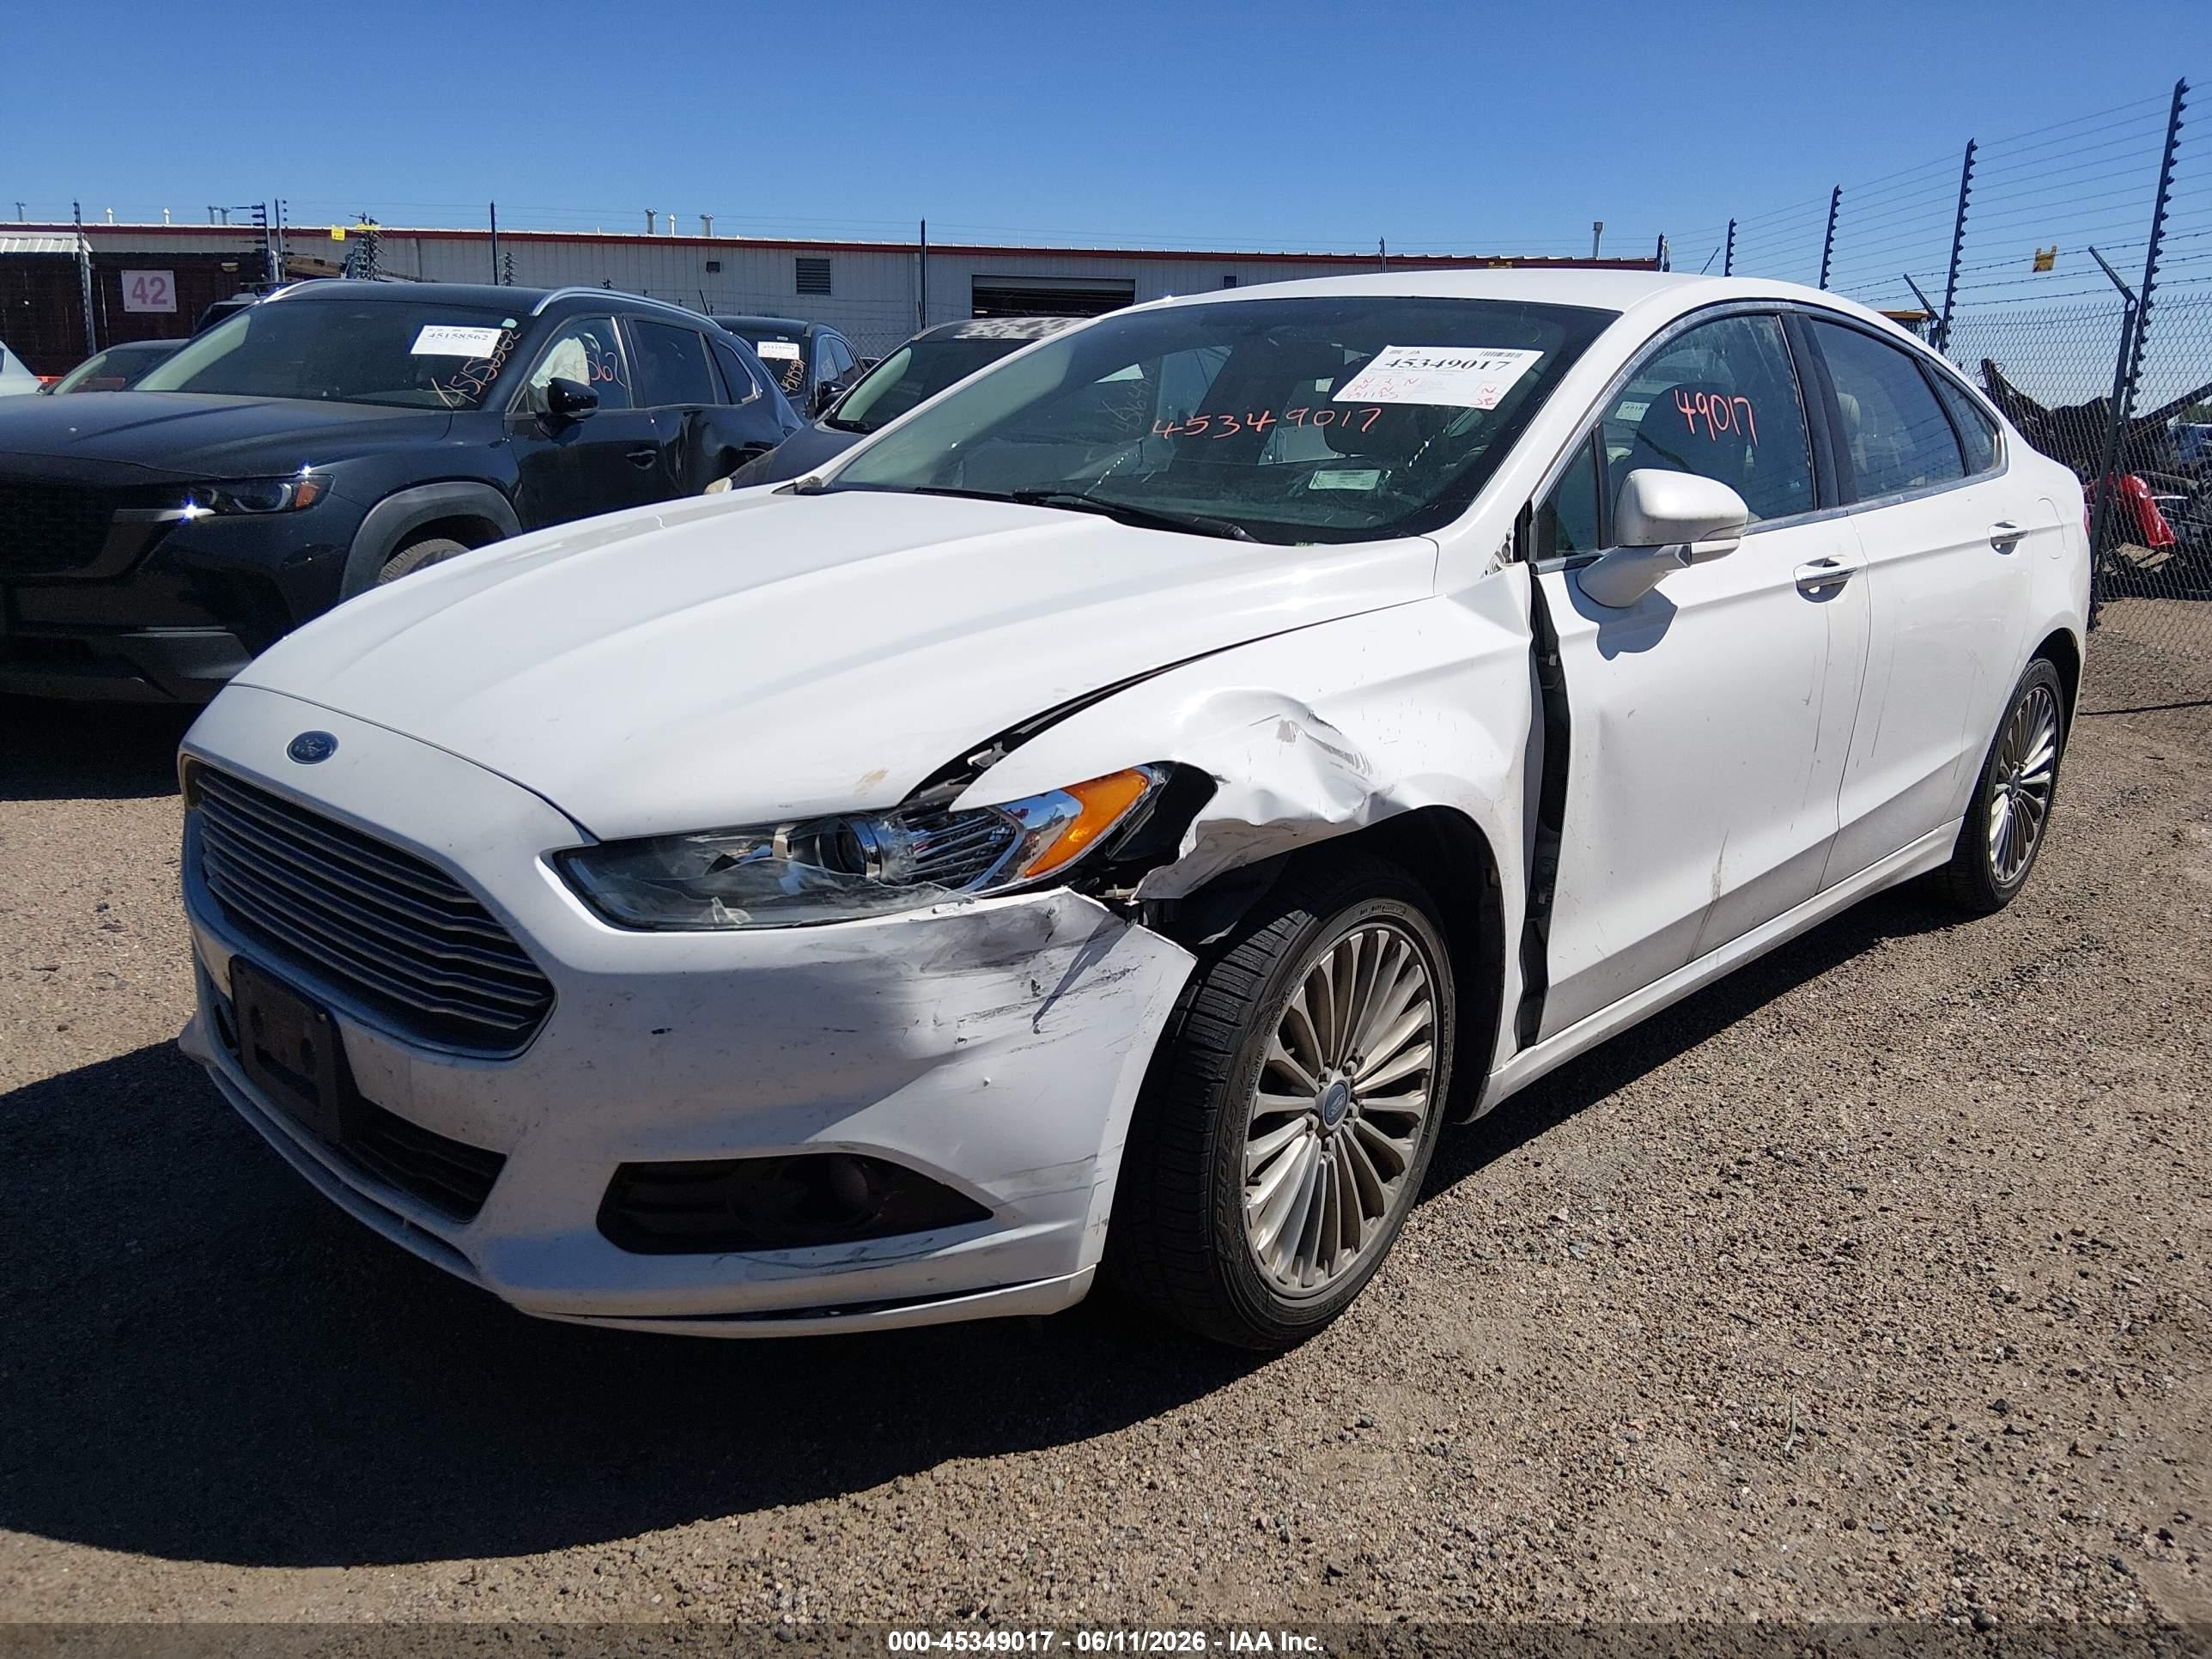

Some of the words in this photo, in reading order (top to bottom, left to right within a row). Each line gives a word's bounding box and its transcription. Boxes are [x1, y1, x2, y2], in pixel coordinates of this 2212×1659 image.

[131, 276, 167, 305] 42
[428, 332, 489, 341] 45158562
[1385, 358, 1513, 371] 45349017
[1152, 407, 1382, 440] 45349017
[1675, 389, 1759, 447] 49017
